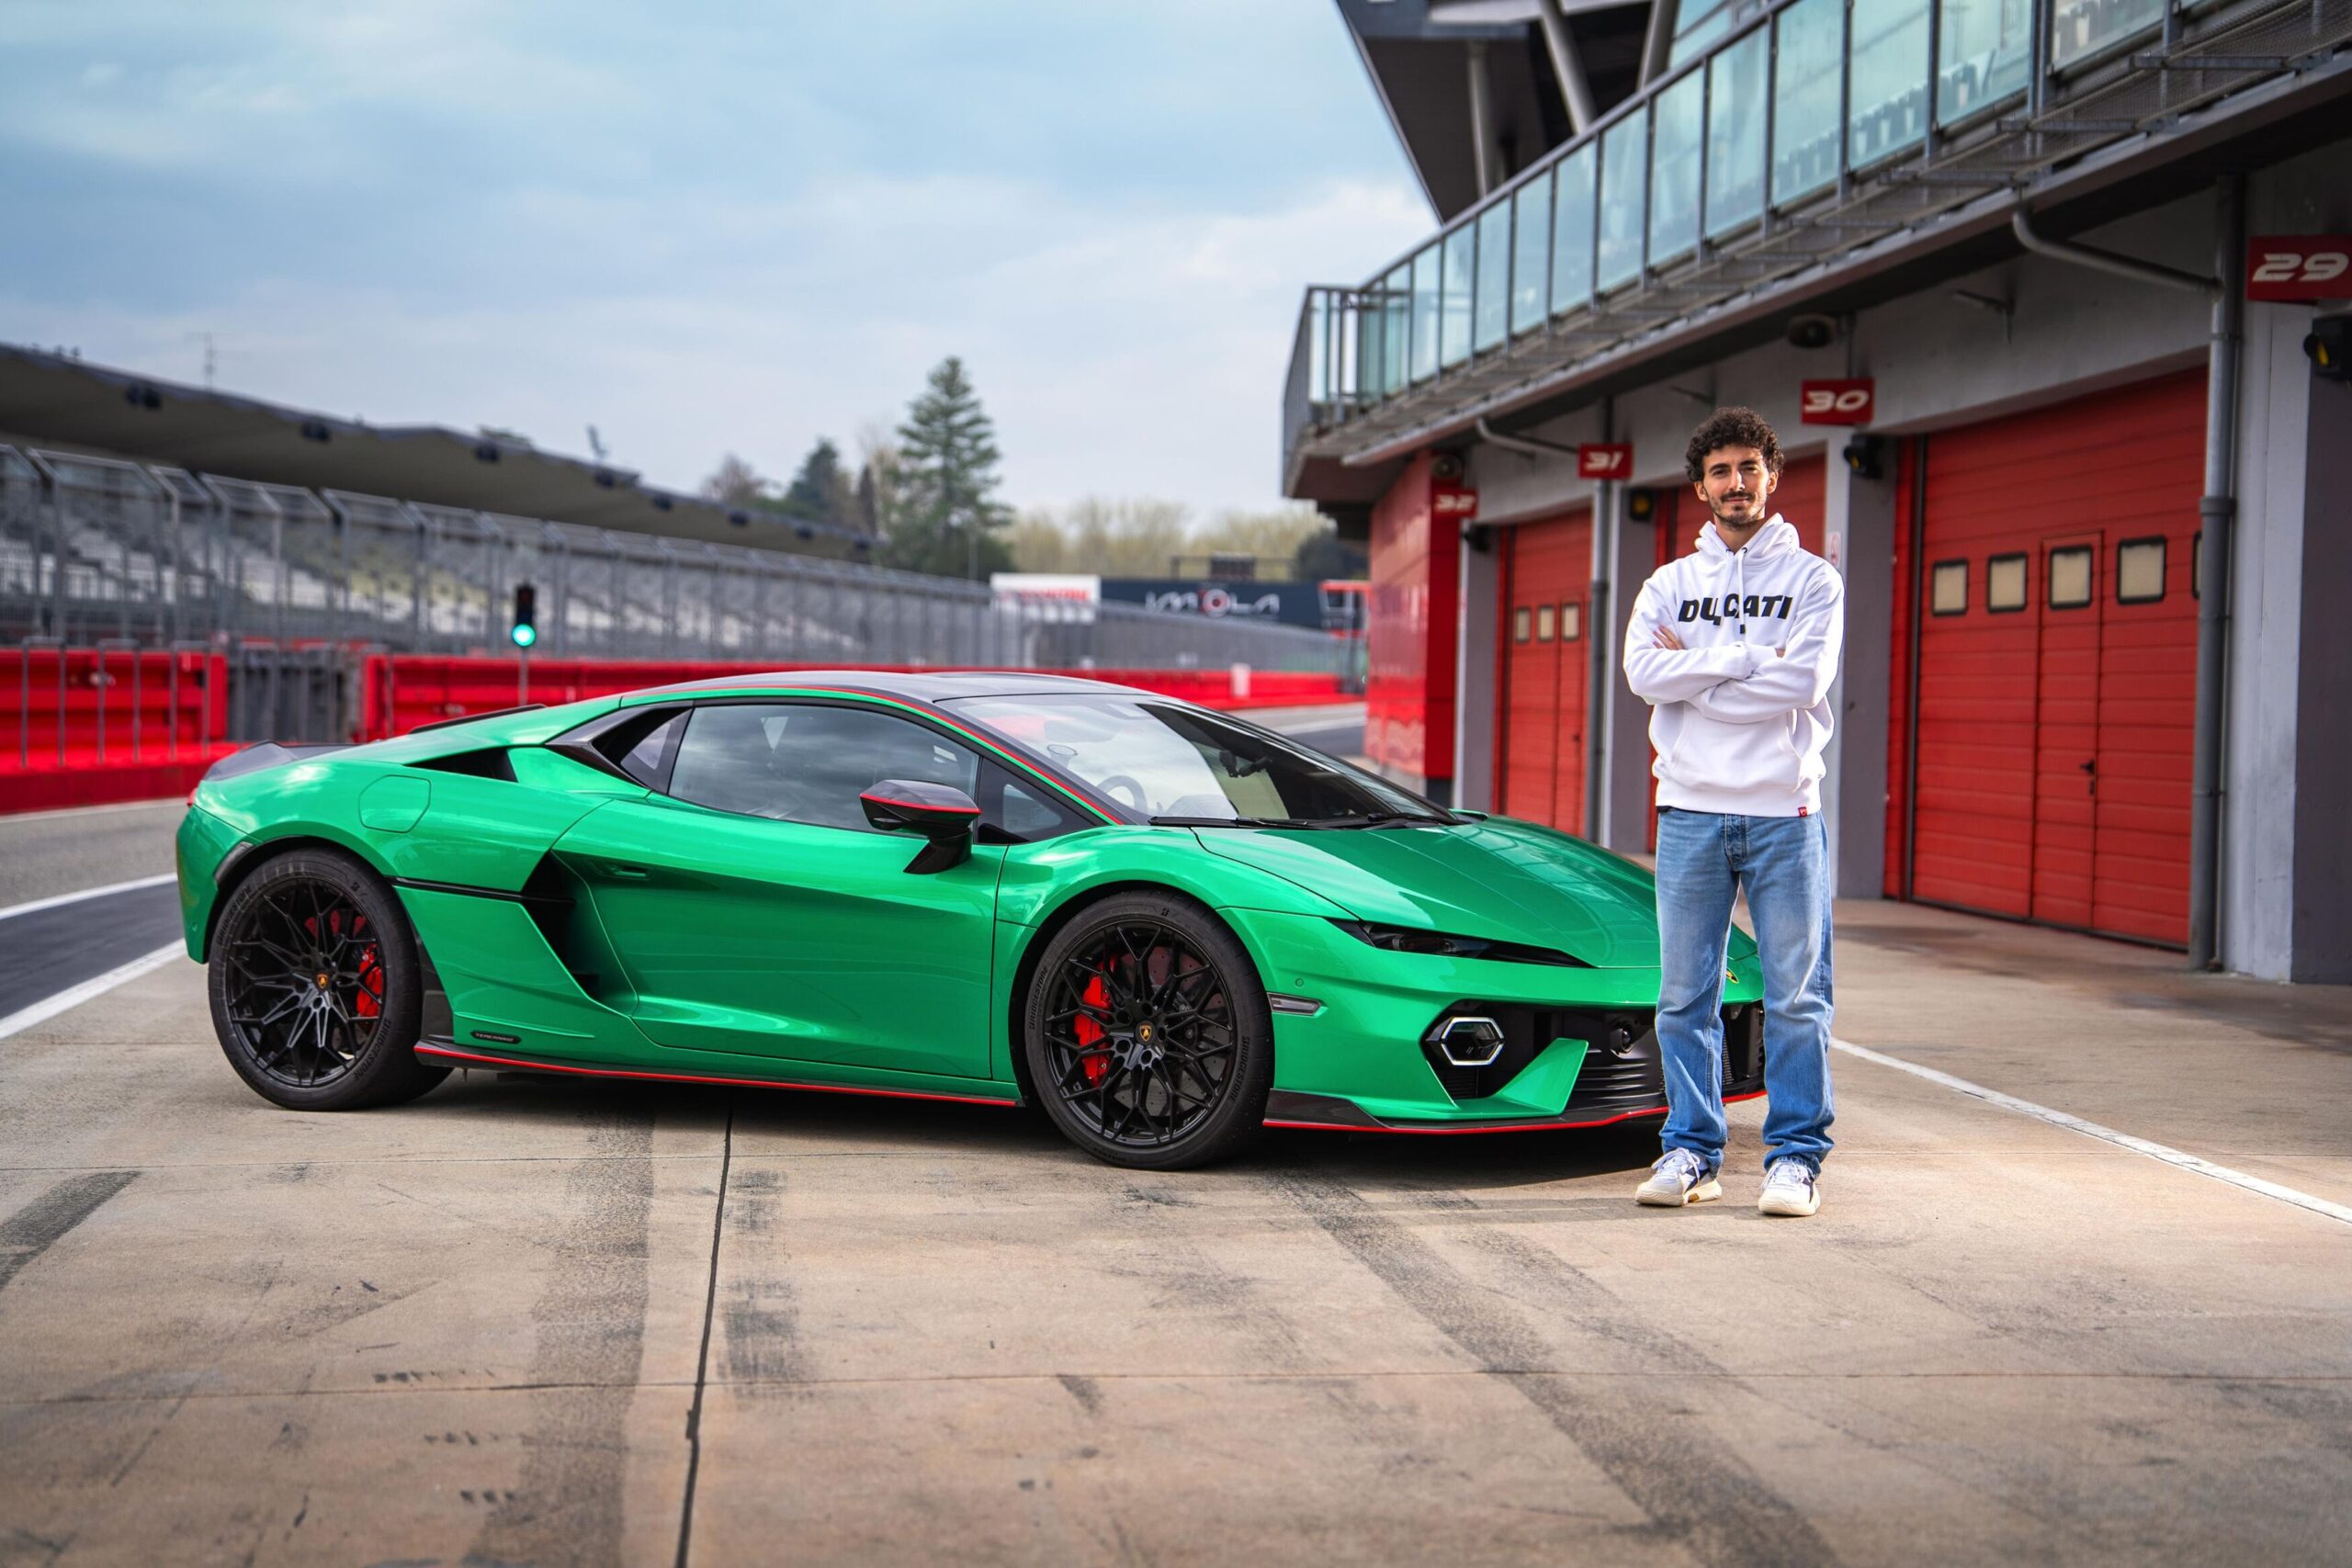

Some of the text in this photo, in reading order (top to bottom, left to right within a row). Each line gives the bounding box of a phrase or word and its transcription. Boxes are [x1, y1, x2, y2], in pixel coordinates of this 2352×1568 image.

[2253, 252, 2349, 282] 29
[1804, 389, 1870, 413] 30
[1585, 451, 1624, 471] 31
[1434, 494, 1476, 512] 32
[1678, 593, 1793, 624] DUCATI
[1228, 1035, 1250, 1103] BRIDGESTONE
